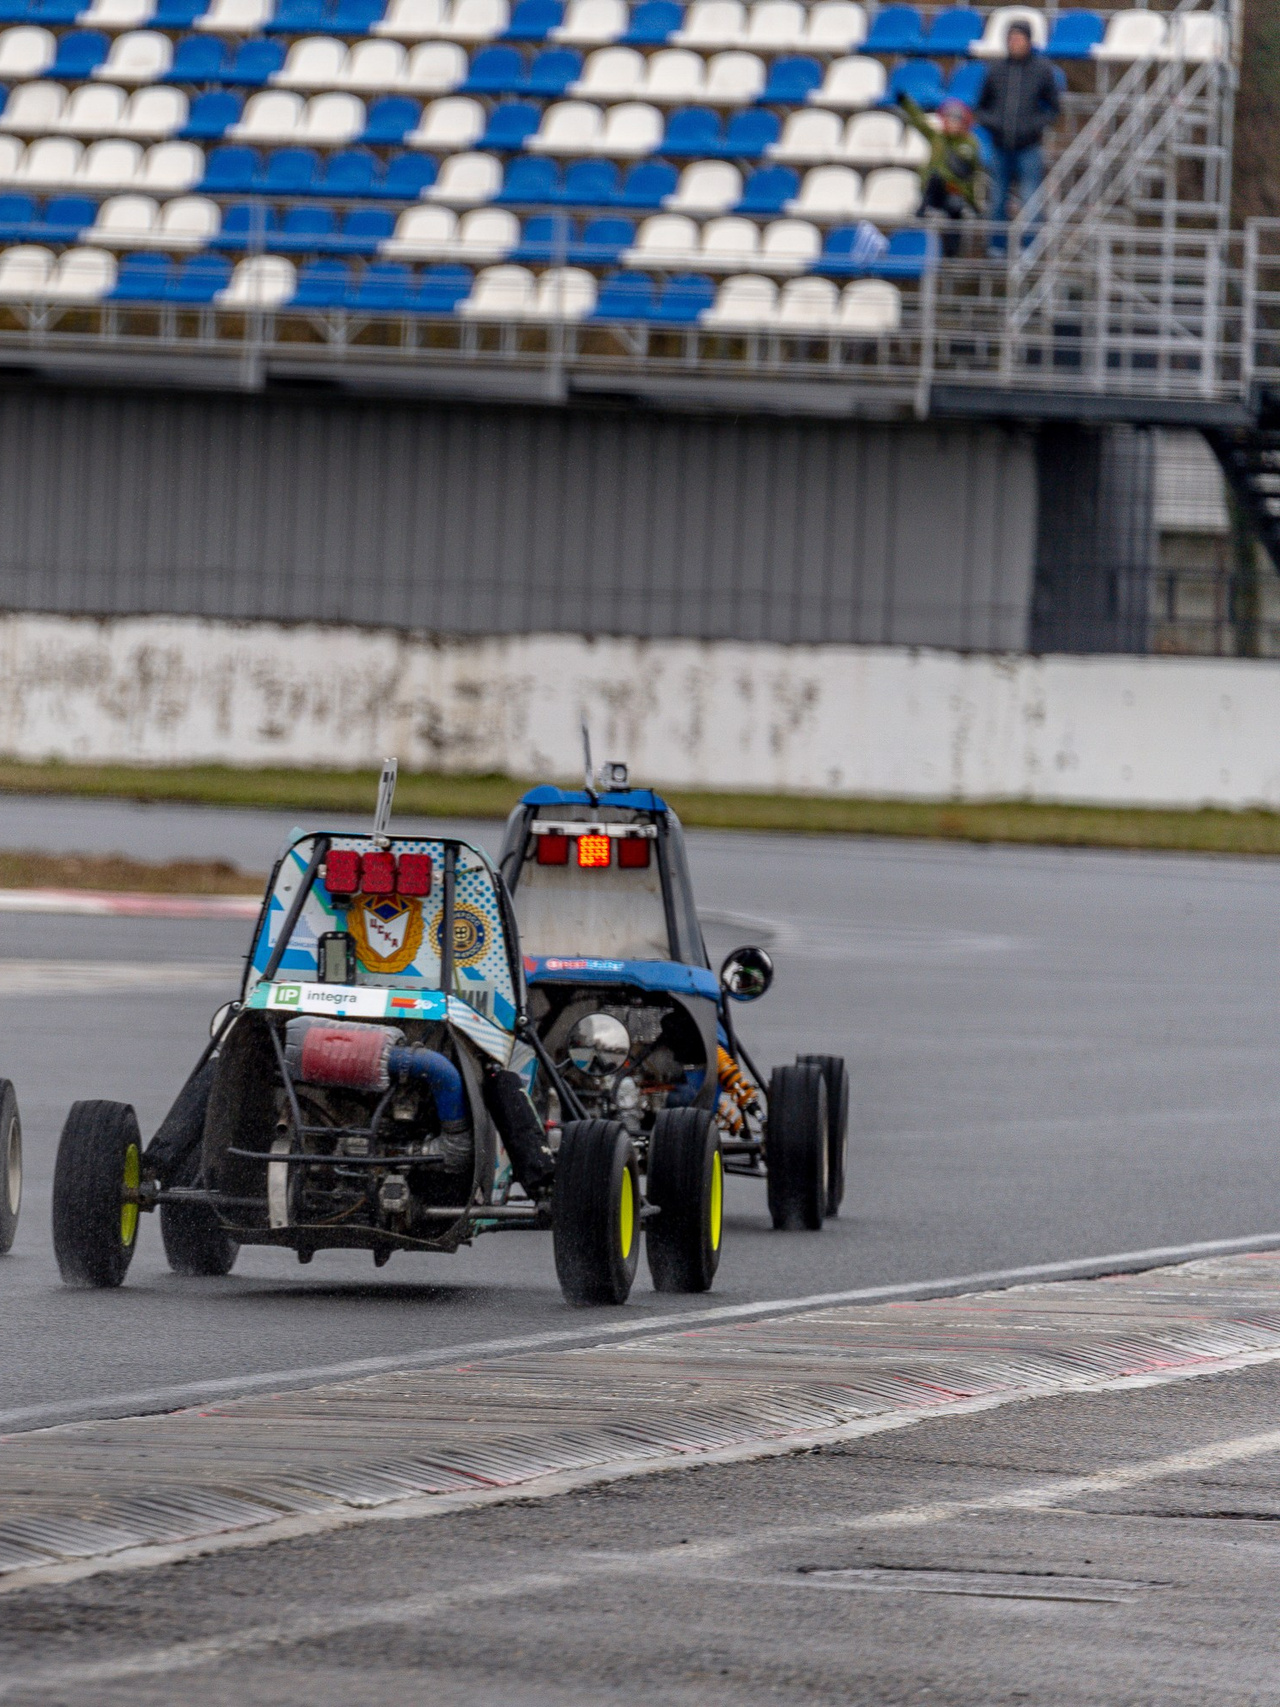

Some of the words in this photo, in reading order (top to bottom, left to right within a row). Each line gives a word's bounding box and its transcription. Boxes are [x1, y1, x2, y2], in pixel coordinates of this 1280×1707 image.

[370, 918, 398, 947] ЦСКА
[279, 988, 298, 1001] IP
[307, 991, 357, 1003] integra
